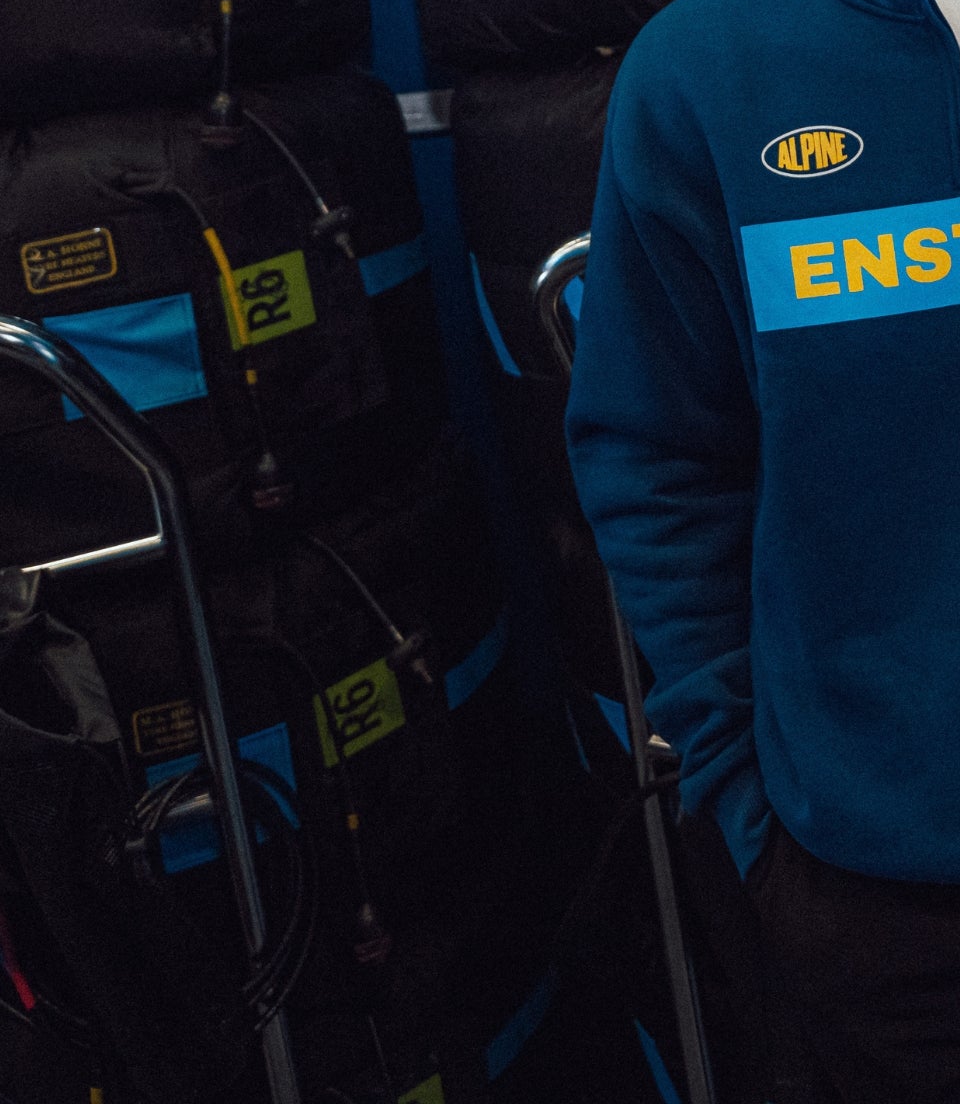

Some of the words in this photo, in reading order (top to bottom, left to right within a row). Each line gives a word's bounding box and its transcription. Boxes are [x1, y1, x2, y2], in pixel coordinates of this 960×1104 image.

[777, 131, 849, 172] ALPINE
[241, 269, 292, 331] R6
[334, 679, 382, 742] R6
